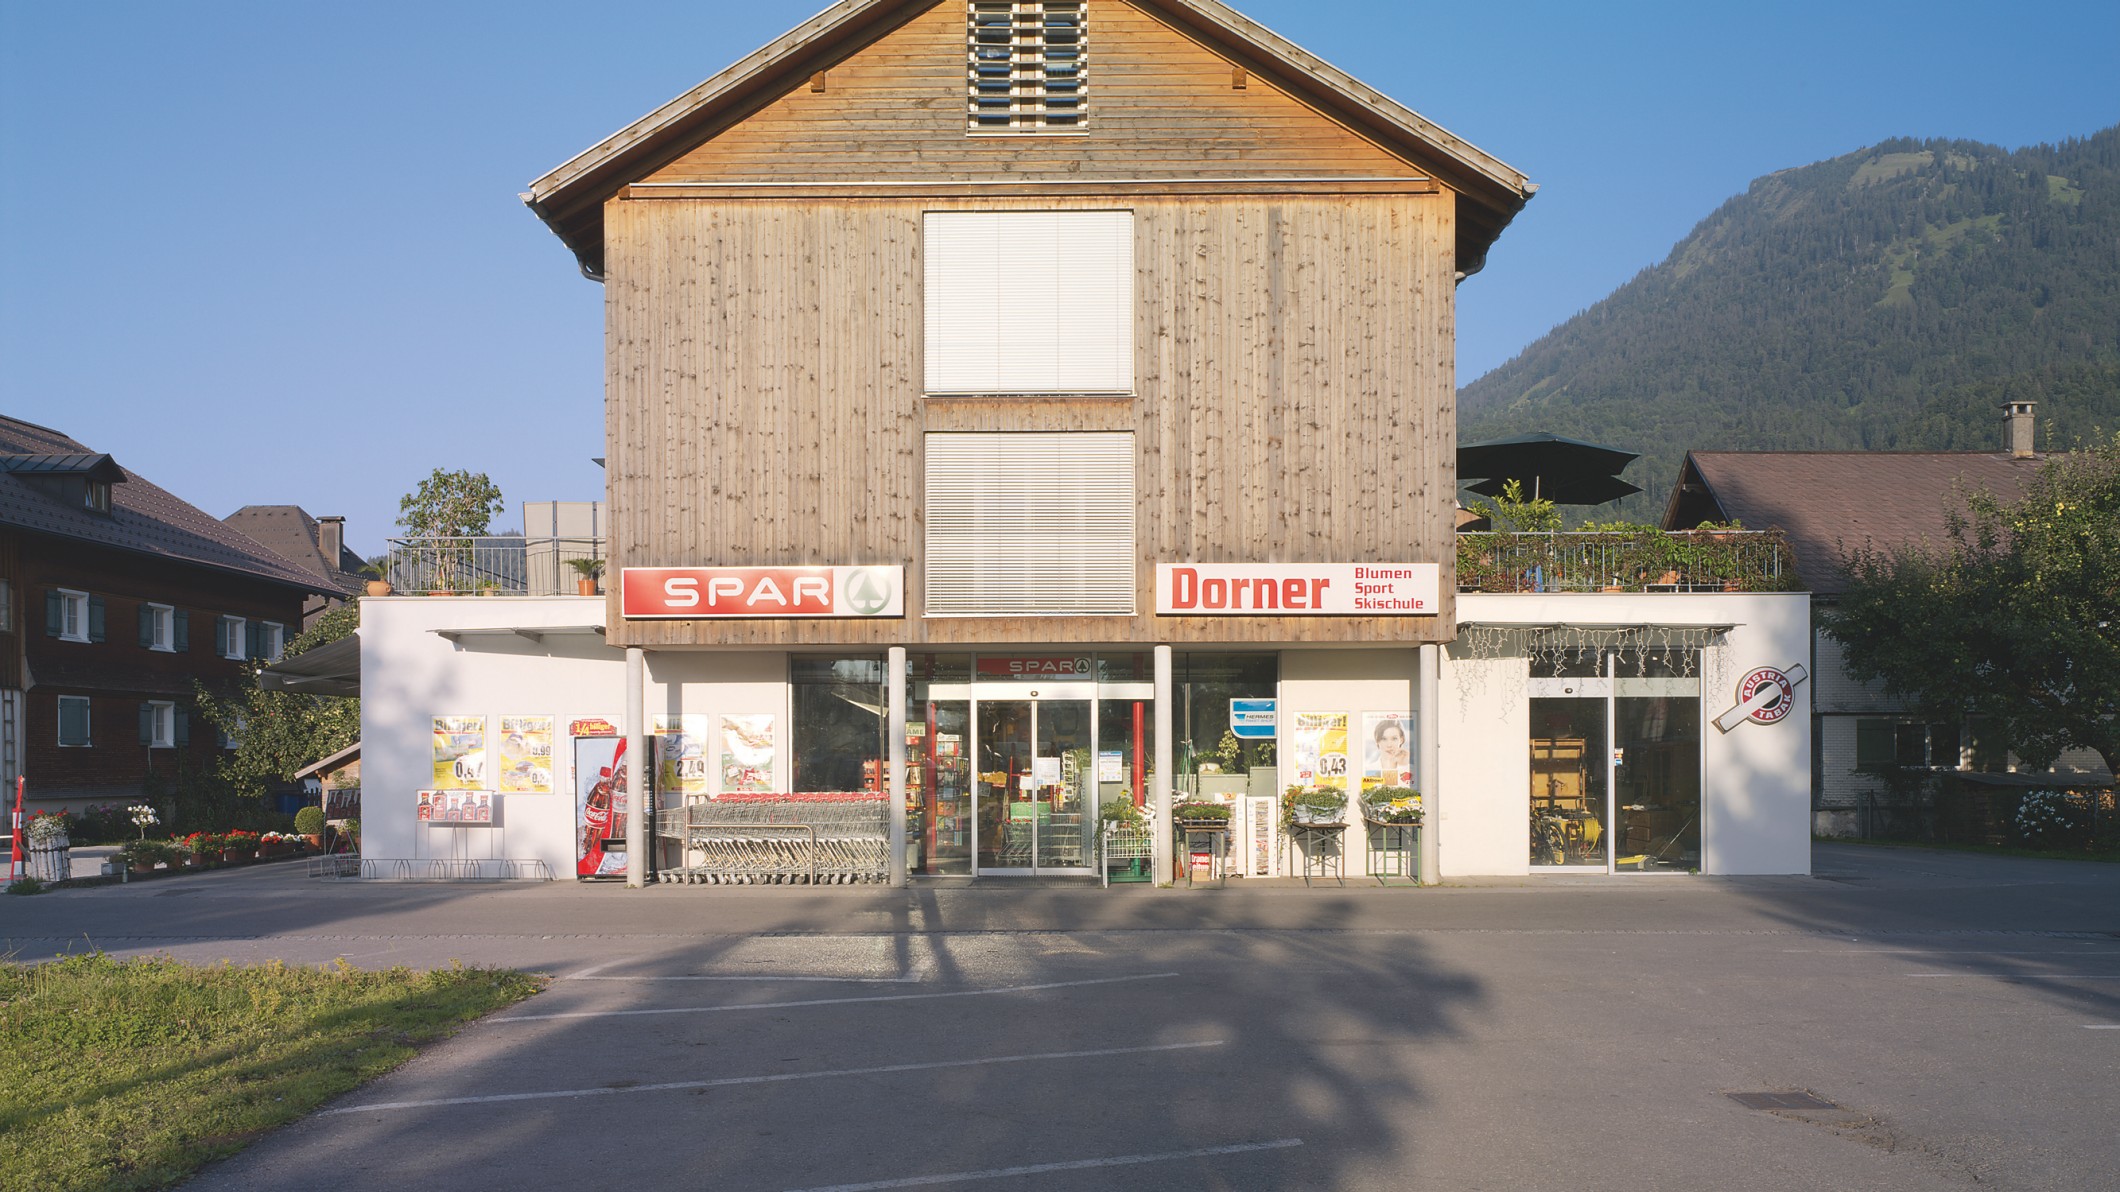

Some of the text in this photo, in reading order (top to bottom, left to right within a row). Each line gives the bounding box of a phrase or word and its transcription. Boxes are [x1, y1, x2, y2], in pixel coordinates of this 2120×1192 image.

[1355, 567, 1412, 579] Blumen
[664, 577, 830, 607] SPAR
[1171, 567, 1330, 609] Dorner
[1355, 582, 1394, 595] Sport
[1355, 597, 1424, 610] Skischule
[1009, 661, 1074, 672] SPAR
[1743, 671, 1788, 698] AUSTRIA
[1759, 694, 1791, 719] TABAK
[435, 718, 483, 732] Biiger!
[1319, 757, 1347, 776] 0,43
